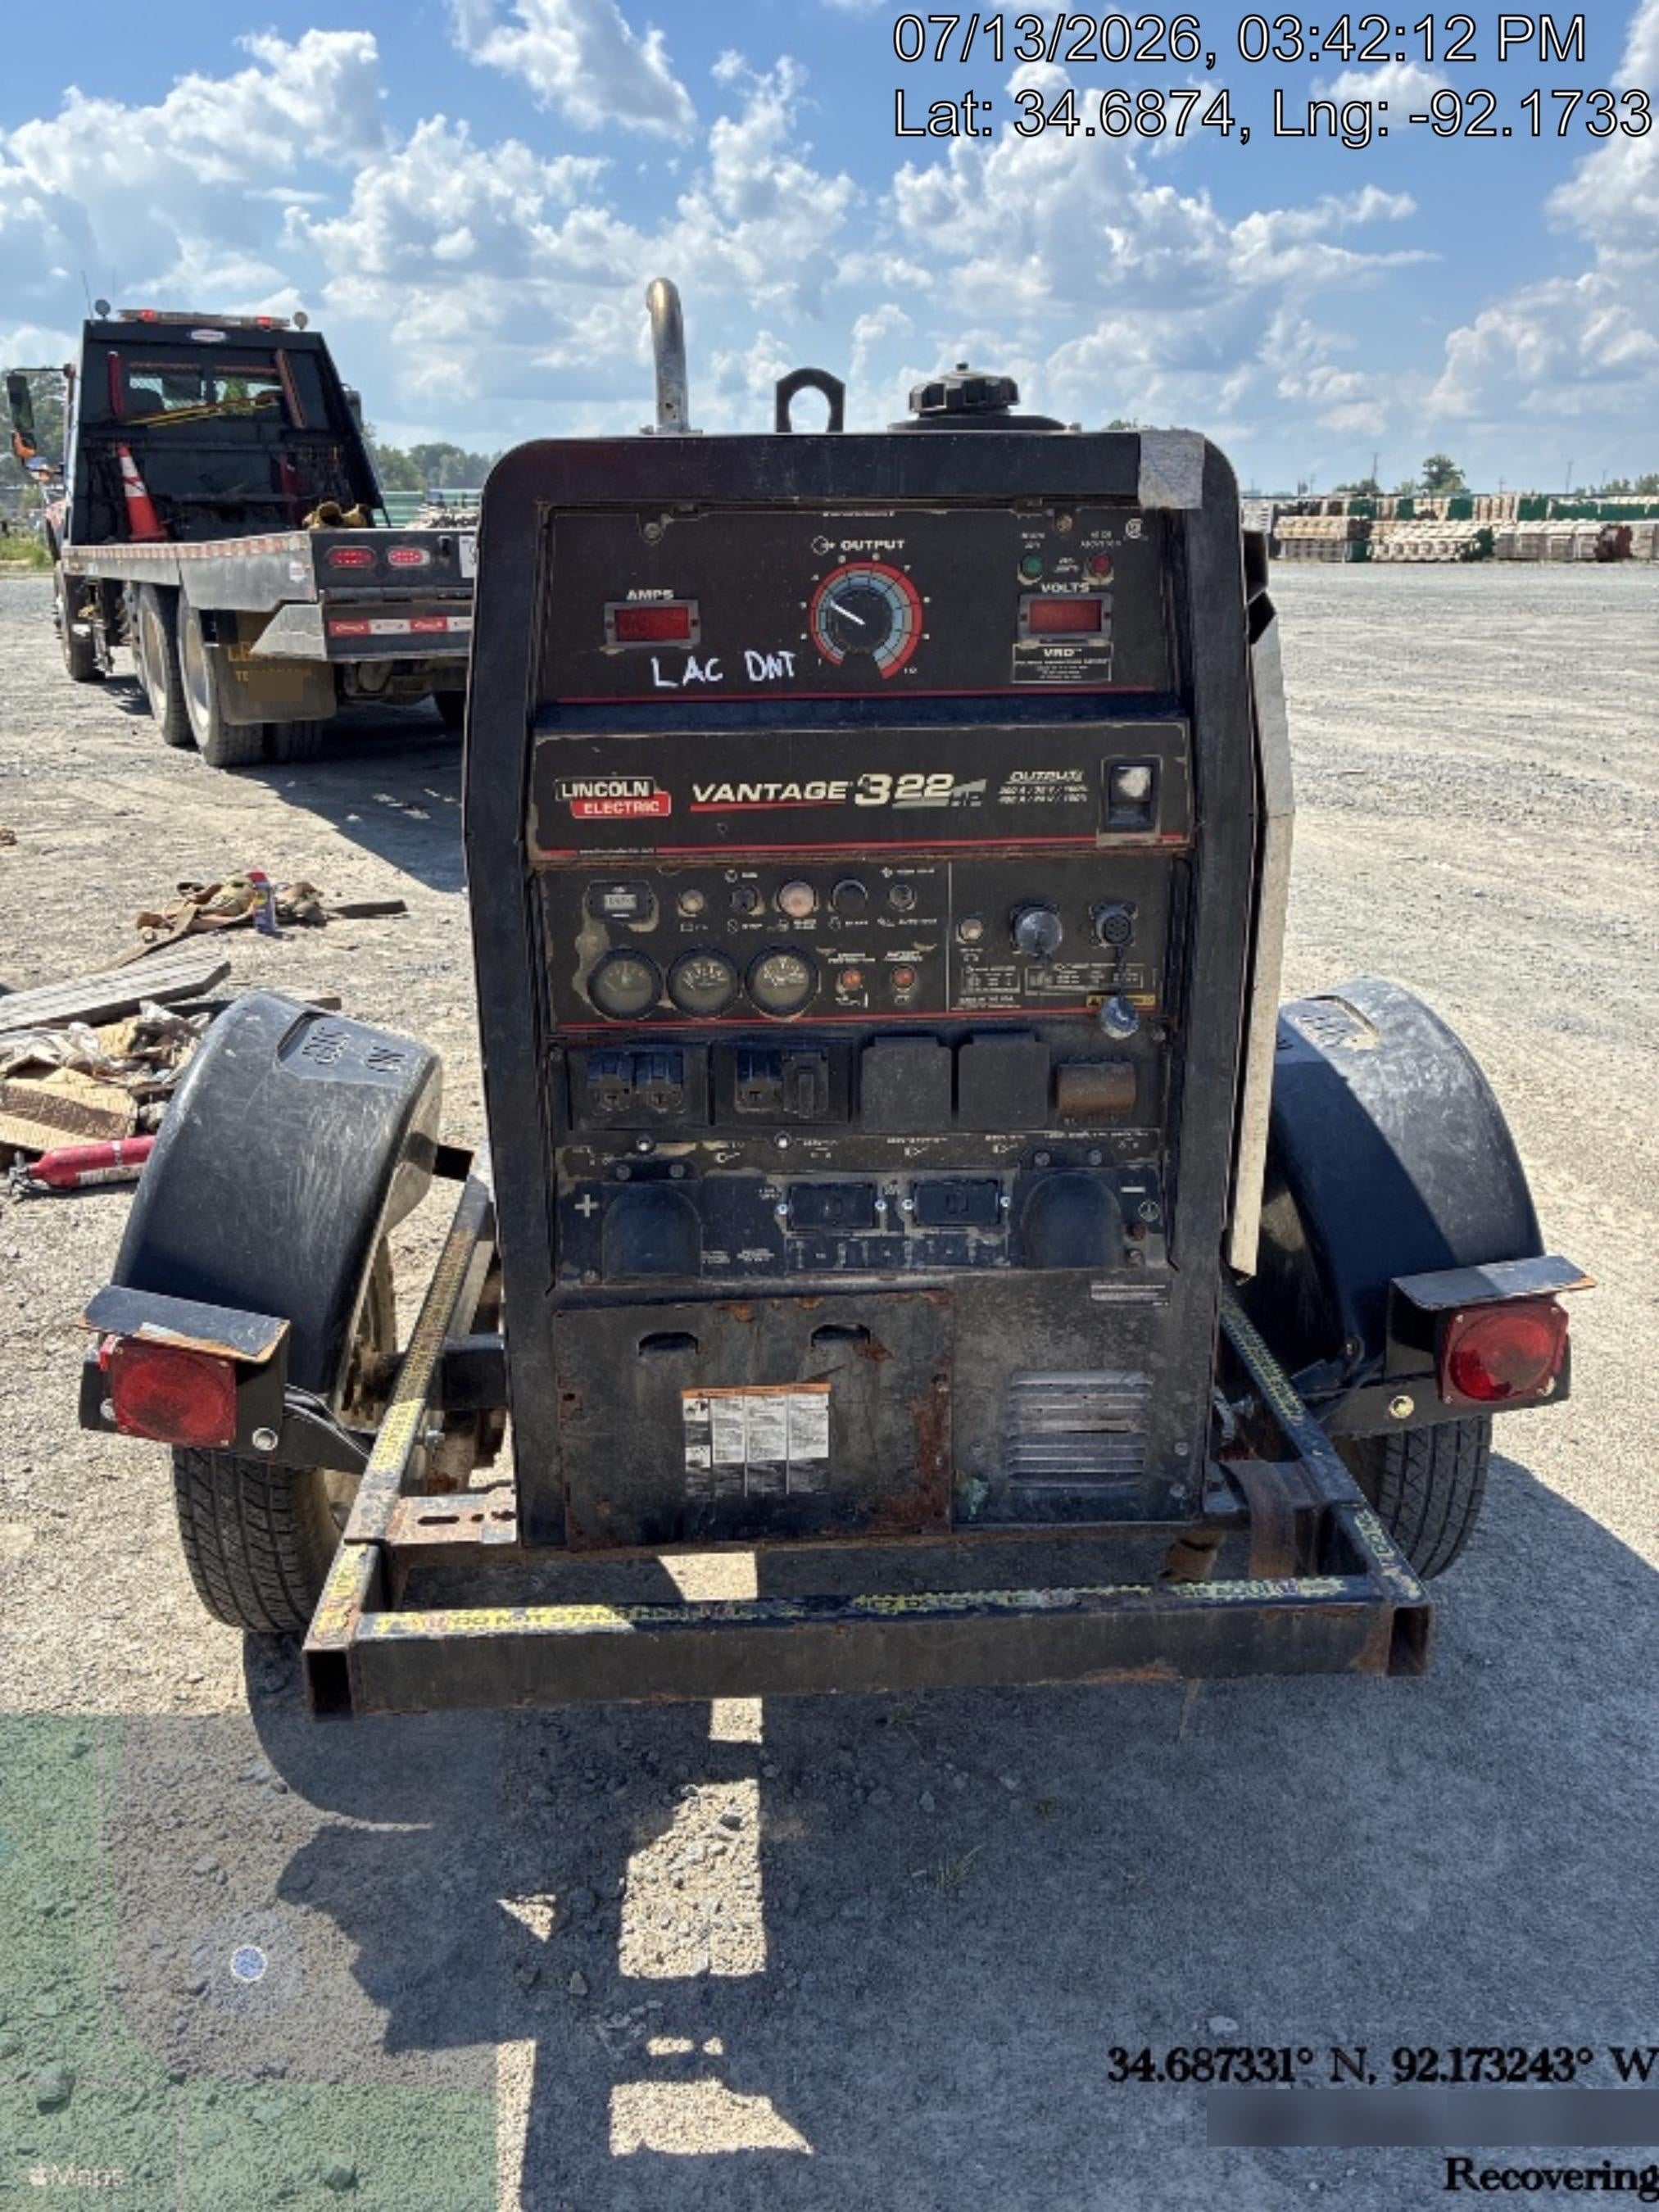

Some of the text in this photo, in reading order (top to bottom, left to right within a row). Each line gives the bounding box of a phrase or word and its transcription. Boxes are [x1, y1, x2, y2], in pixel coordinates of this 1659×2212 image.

[840, 540, 905, 551] OUTPUT
[1040, 582, 1090, 593] VOLTS
[626, 589, 674, 601] AMPS
[561, 780, 650, 799] LINCOLN
[692, 773, 954, 806] VANTAGE 322
[583, 800, 660, 815] ELECTRIC
